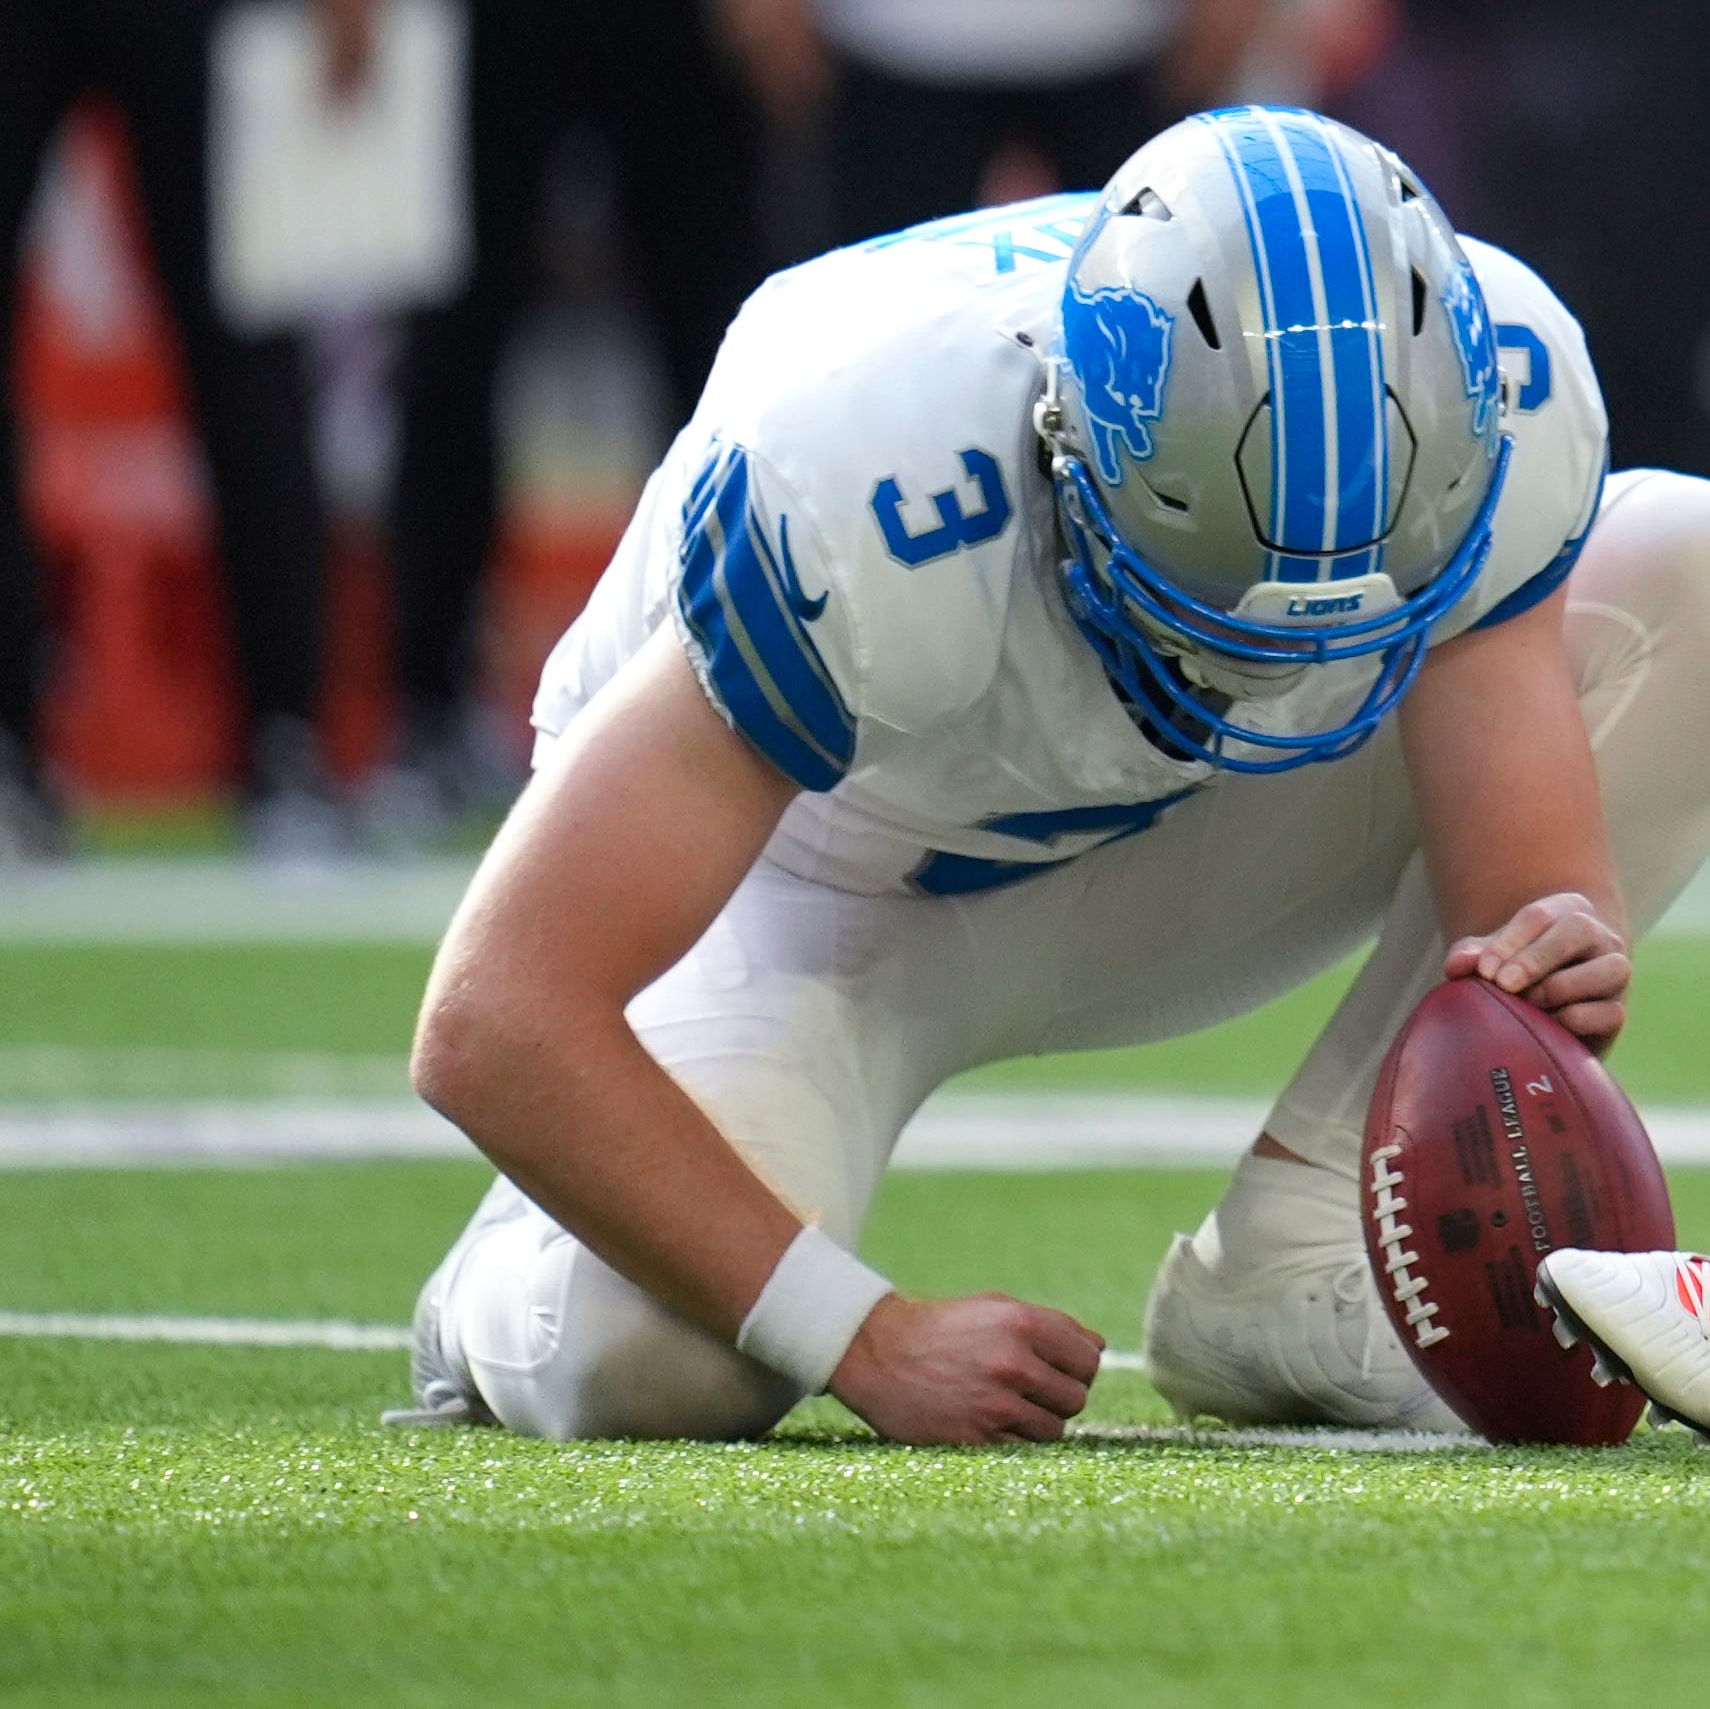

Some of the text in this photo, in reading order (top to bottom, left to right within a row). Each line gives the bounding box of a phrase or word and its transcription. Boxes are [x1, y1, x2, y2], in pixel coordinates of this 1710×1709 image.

[872, 445, 1014, 570] 3
[1490, 1066, 1524, 1139] LEAGUE
[1525, 1074, 1553, 1097] 2
[1511, 1145, 1550, 1251] FOOTBALL
